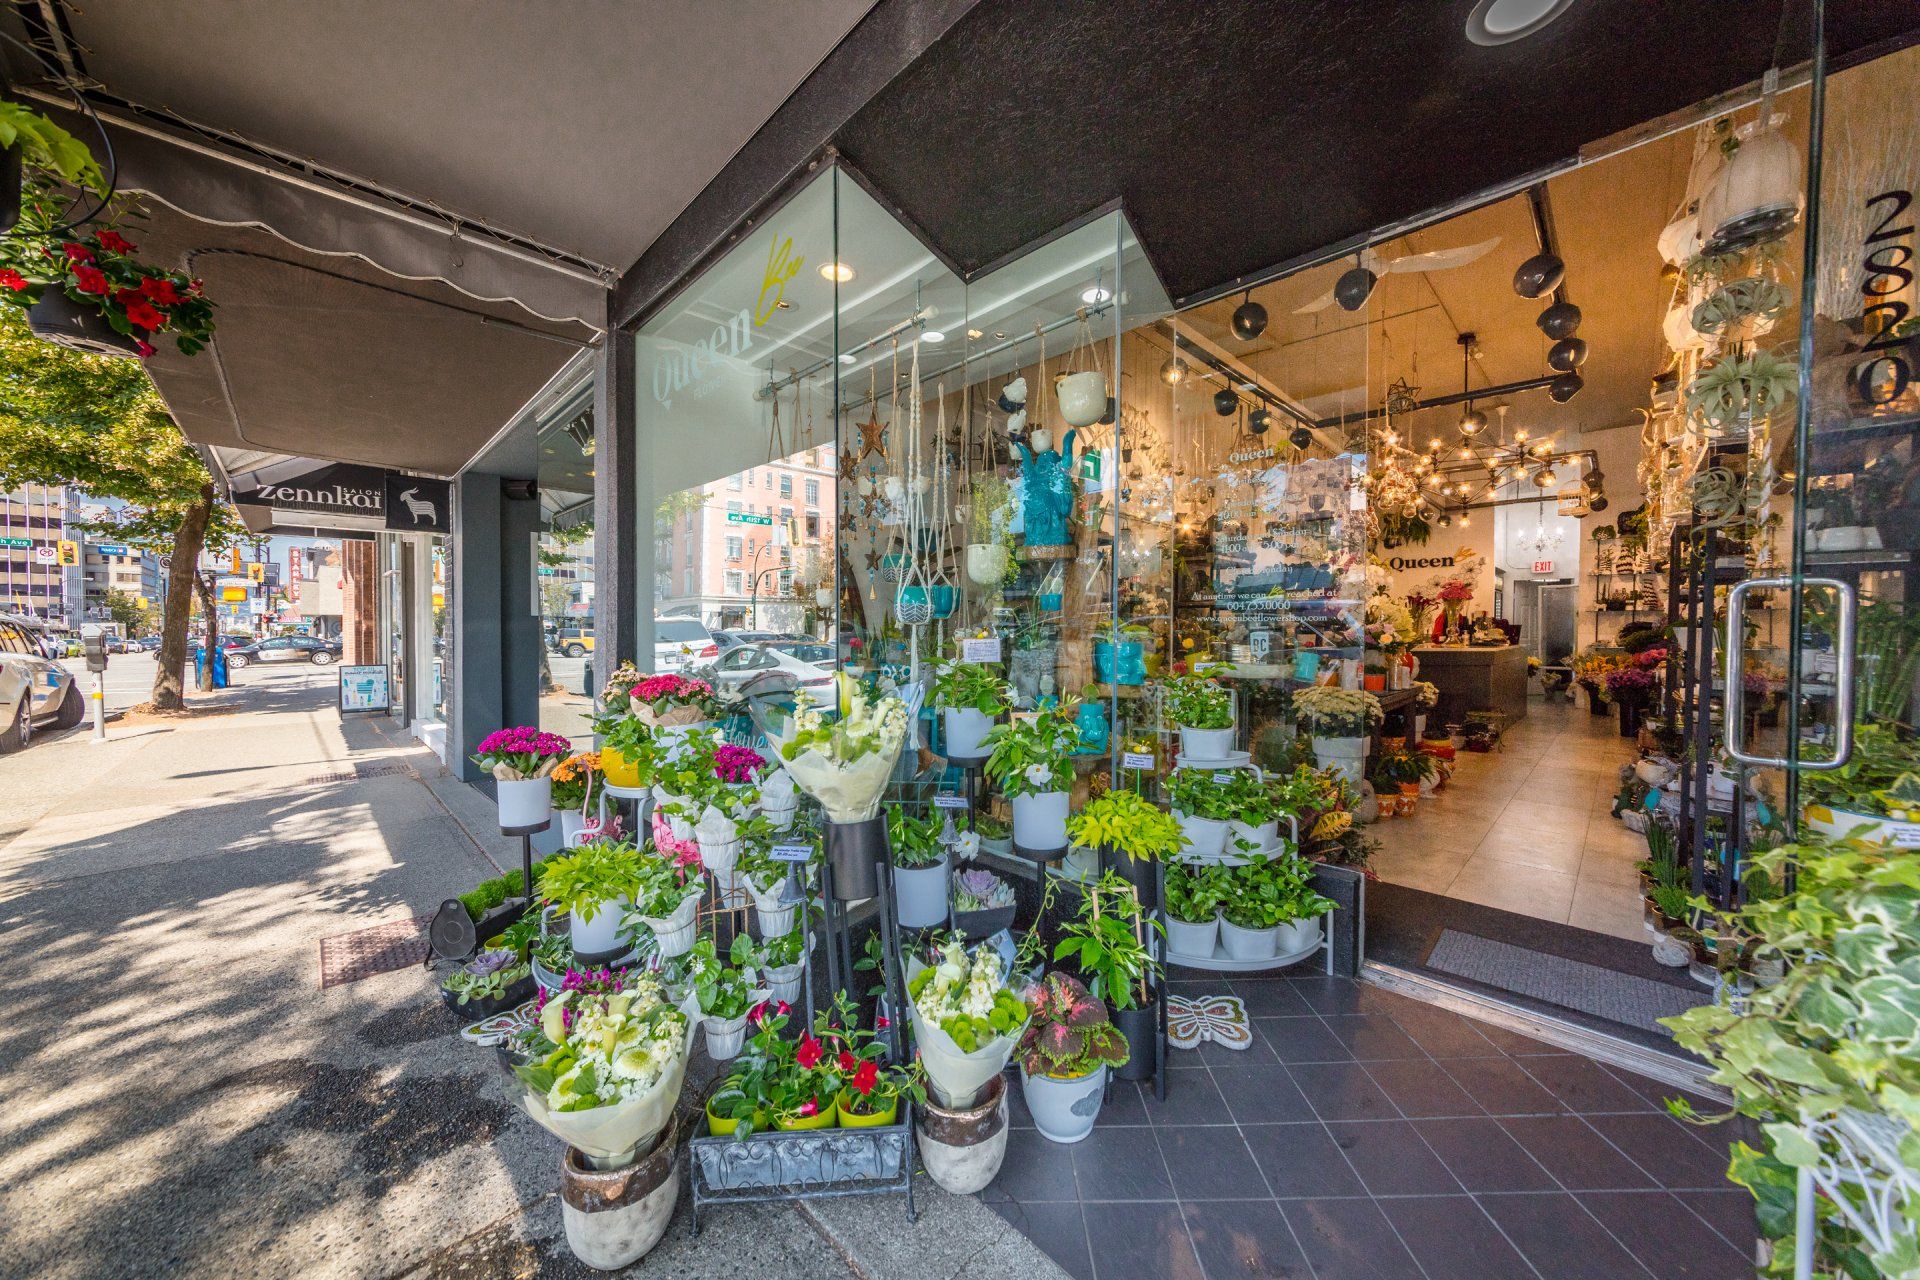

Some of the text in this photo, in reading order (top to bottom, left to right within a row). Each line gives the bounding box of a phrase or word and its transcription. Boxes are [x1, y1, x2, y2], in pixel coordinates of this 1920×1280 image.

[1858, 190, 1917, 405] 2820
[1228, 448, 1275, 465] Queen
[342, 487, 382, 496] SALON
[1389, 556, 1456, 573] Queen
[1534, 561, 1552, 572] EXIT
